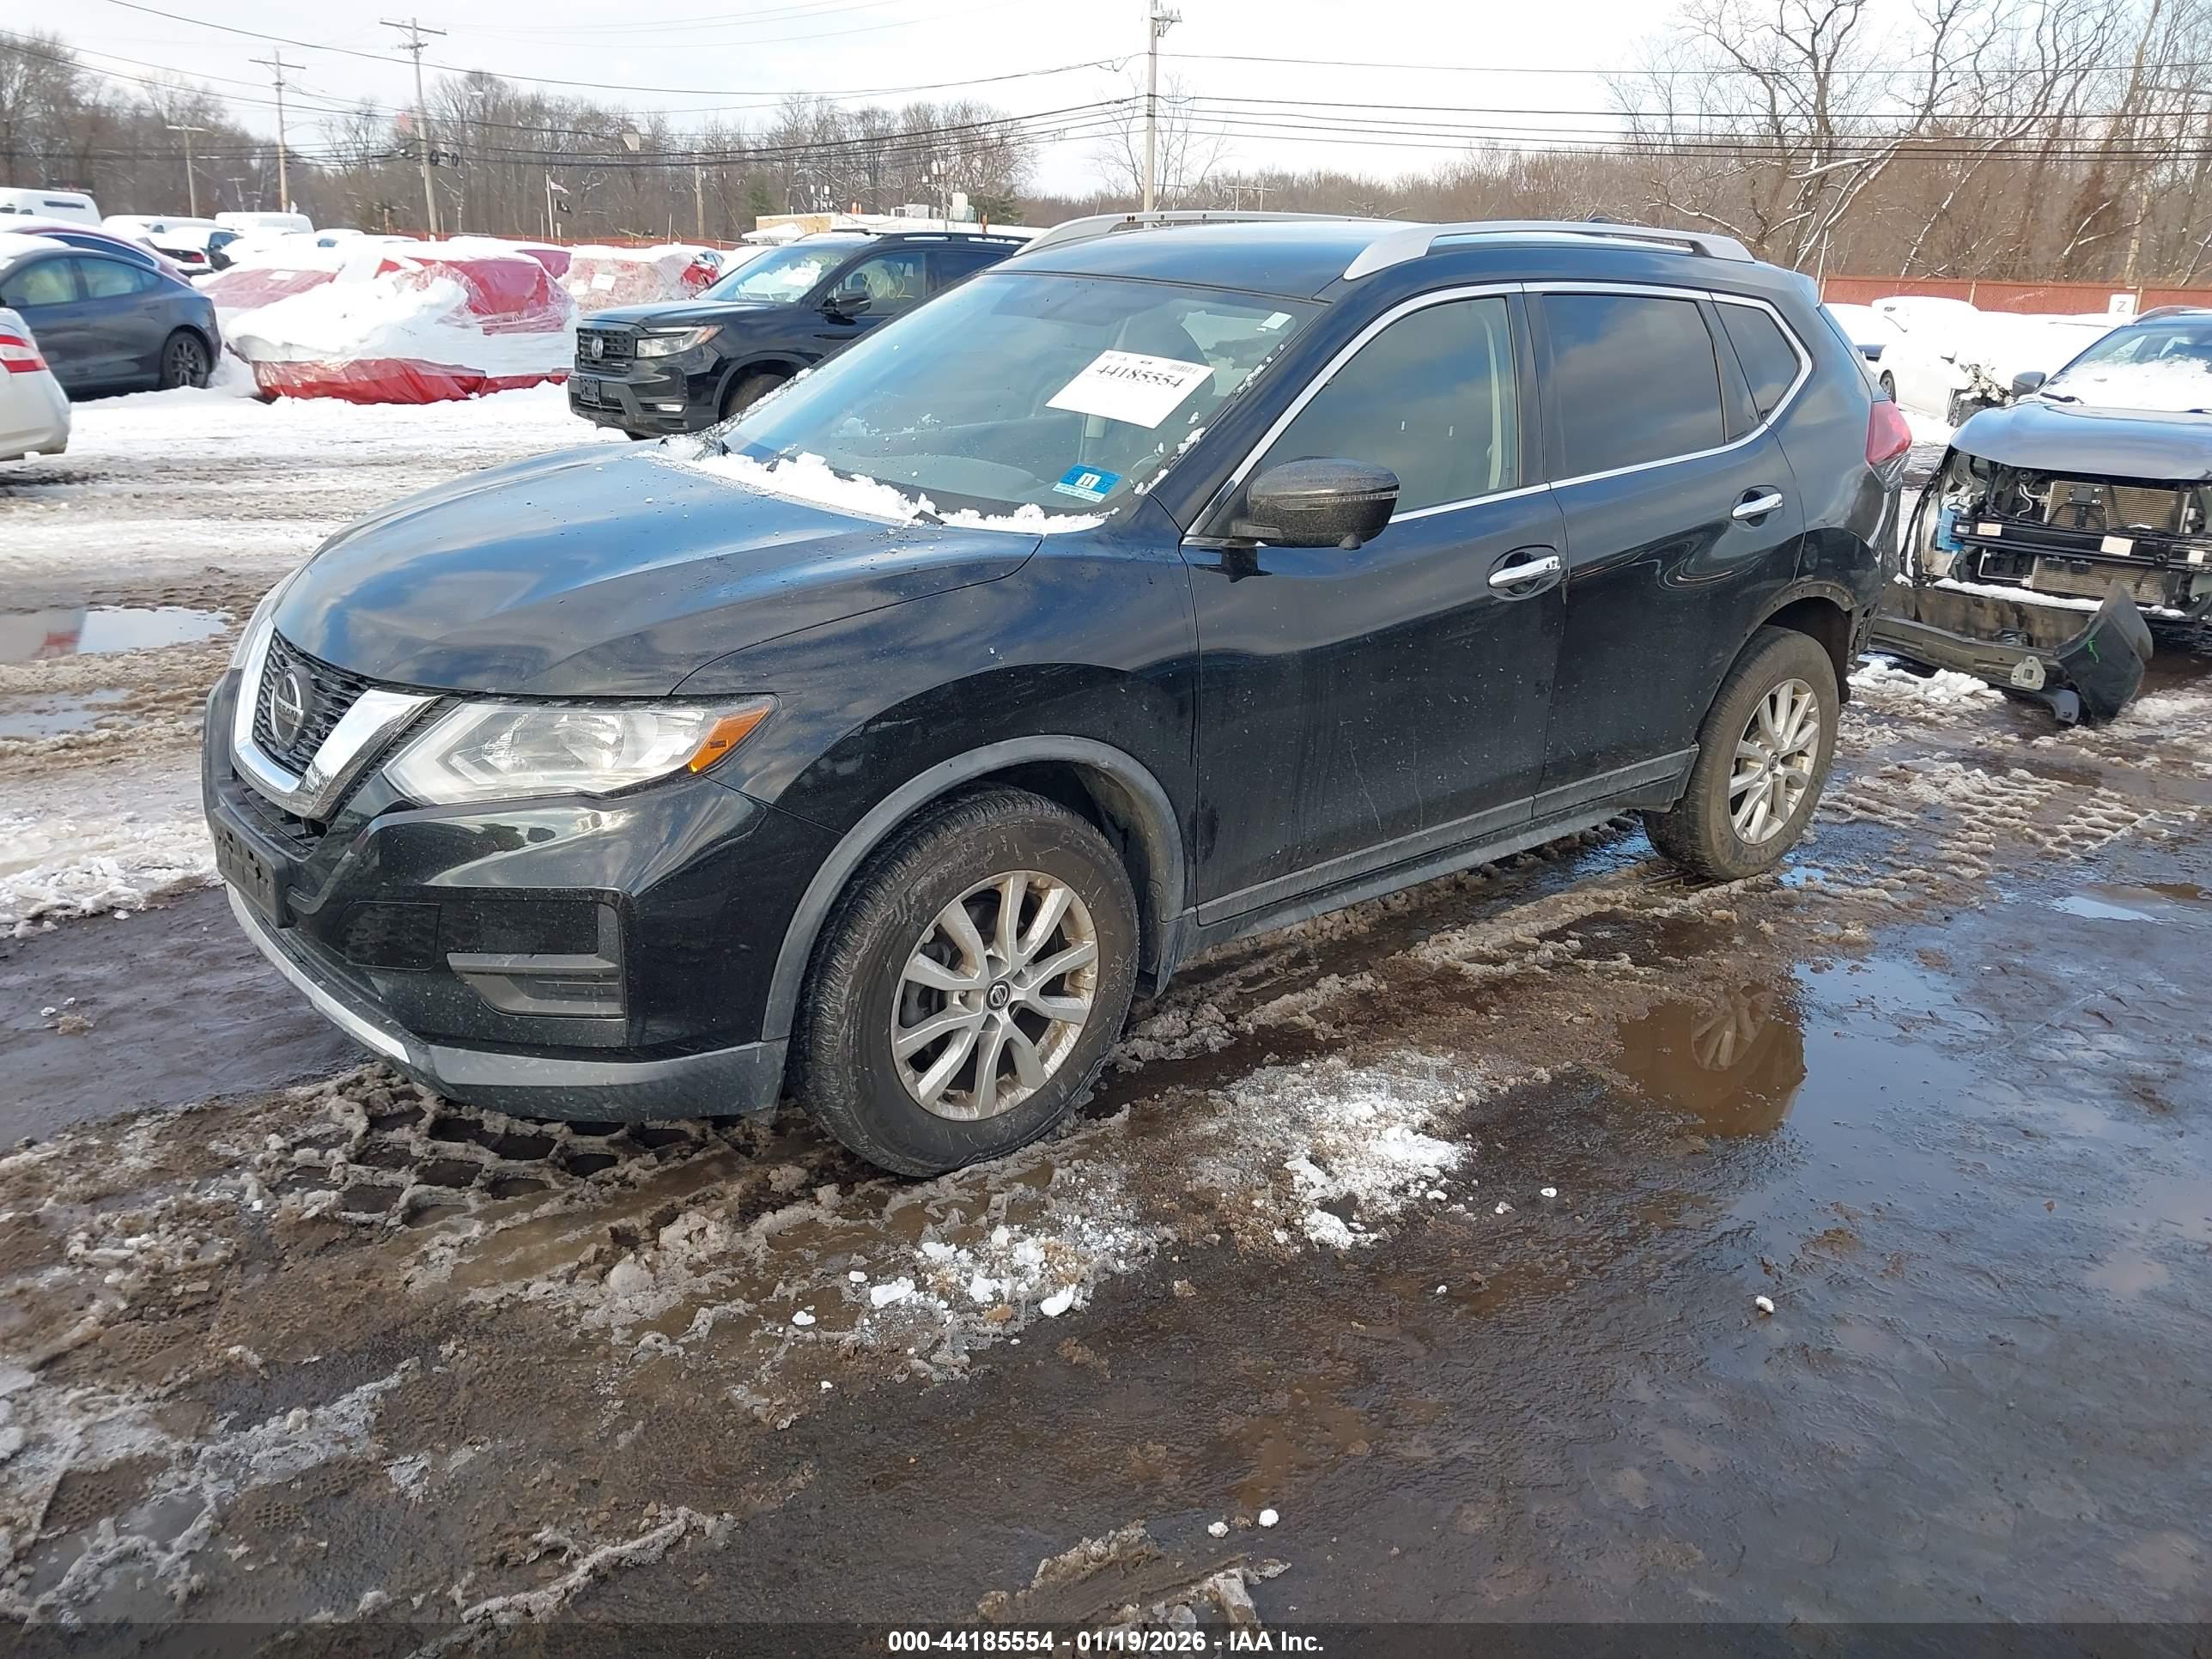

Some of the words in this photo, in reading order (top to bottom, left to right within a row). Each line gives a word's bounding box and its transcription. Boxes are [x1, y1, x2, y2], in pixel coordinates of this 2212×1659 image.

[2116, 301, 2127, 313] Z
[1097, 364, 1185, 389] 44185554
[1079, 475, 1095, 487] 11
